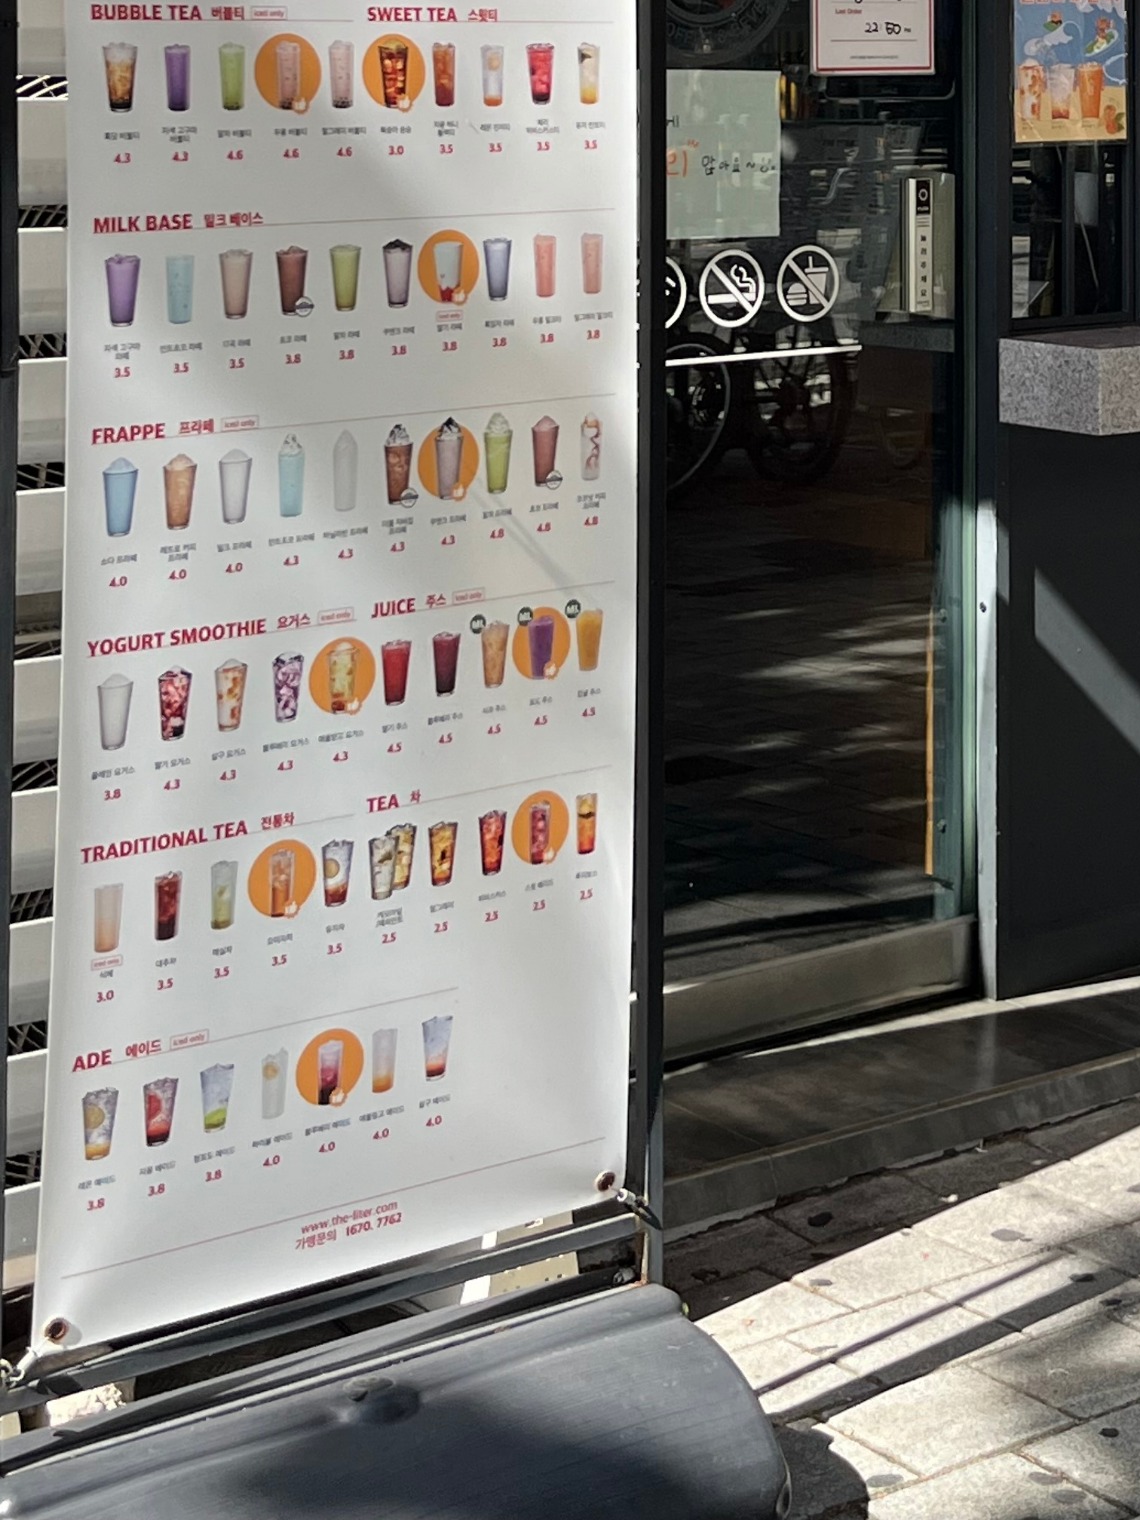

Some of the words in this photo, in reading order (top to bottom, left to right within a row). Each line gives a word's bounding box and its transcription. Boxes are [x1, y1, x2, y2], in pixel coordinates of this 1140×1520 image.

[91, 3, 163, 21] BUBBLE
[169, 4, 203, 21] TEA
[210, 6, 246, 21] 버블티
[367, 6, 423, 22] SWEET
[427, 7, 458, 22] TEA
[93, 215, 141, 234] MILK
[146, 213, 193, 231] BASE
[91, 422, 166, 446] FRAPPE
[178, 417, 216, 436] 프라페
[371, 597, 416, 619] JUICE
[425, 593, 448, 609] 주스
[87, 631, 166, 658] YOGURT
[169, 618, 267, 647] SMOOTHIE
[366, 793, 399, 813] TEA
[80, 826, 209, 865] TRADITIONAL
[212, 820, 249, 841] TEA
[71, 1048, 113, 1073] ADE
[124, 1038, 163, 1059] 에이드
